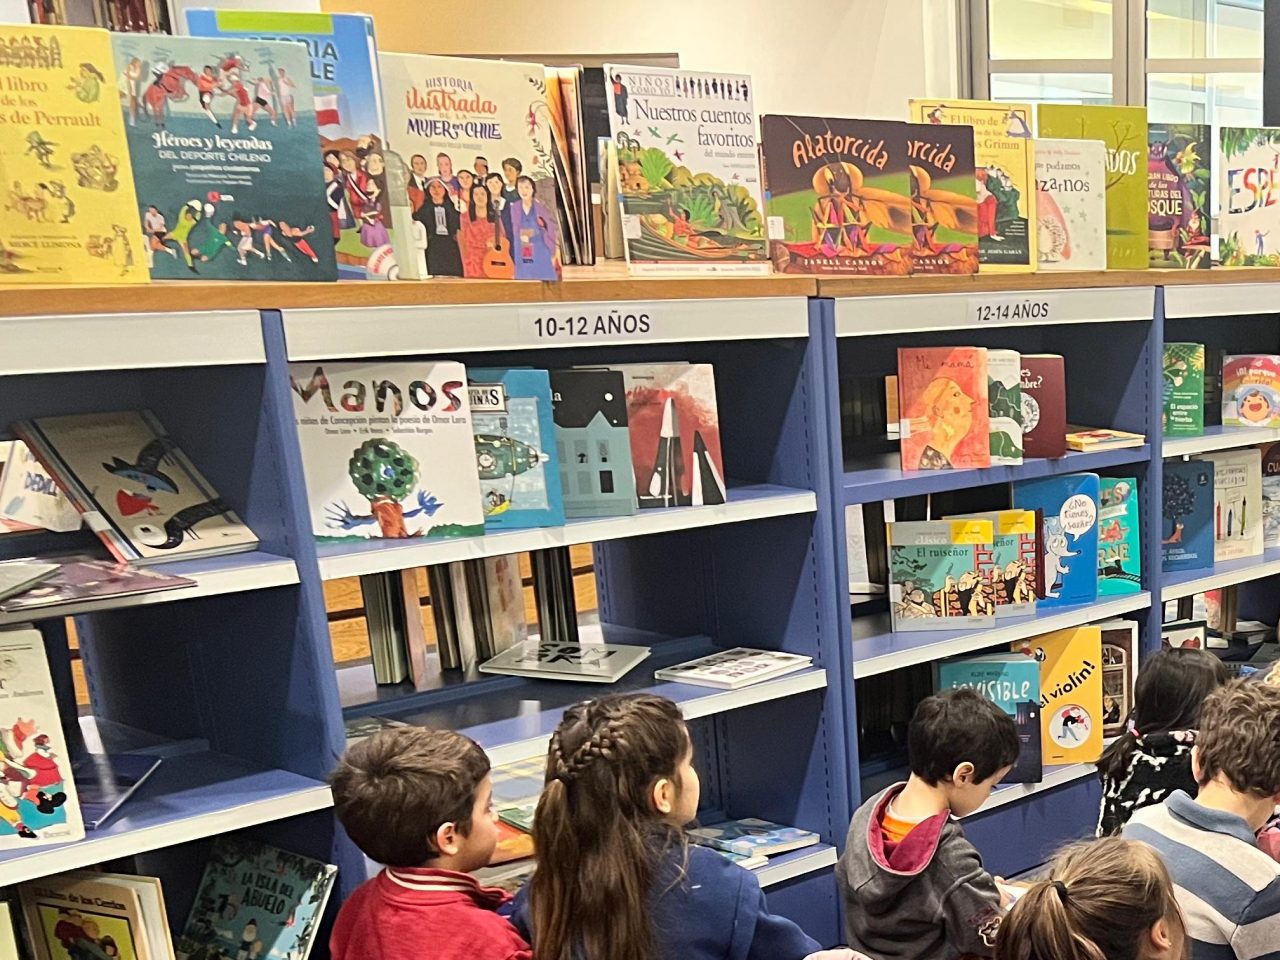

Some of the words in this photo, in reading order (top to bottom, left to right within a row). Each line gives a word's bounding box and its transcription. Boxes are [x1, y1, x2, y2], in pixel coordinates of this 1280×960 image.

[426, 77, 473, 91] HISTORIA
[628, 75, 670, 87] NIÑOS
[406, 86, 497, 114] ilustrada
[34, 111, 101, 127] Perrault
[634, 98, 697, 122] Nuestros
[701, 109, 752, 125] cuentos
[951, 115, 960, 124] El
[963, 115, 985, 125] libro
[987, 116, 999, 125] de
[407, 118, 458, 139] MUJER
[465, 121, 502, 139] CHILE
[698, 124, 754, 147] favoritos
[152, 130, 203, 149] Héroes
[215, 135, 273, 151] leyendas
[985, 141, 1020, 150] Grimm
[158, 150, 179, 160] DEL
[180, 151, 227, 161] DEPORTE
[228, 153, 272, 162] CHILENO
[792, 131, 889, 170] Alatorcida
[1046, 162, 1081, 172] podamos
[1162, 173, 1179, 182] LIBRO
[1170, 190, 1182, 198] DEL
[804, 259, 841, 267] JANELL
[977, 304, 1009, 320] 12-14
[1012, 299, 1049, 319] AÑOS
[534, 316, 588, 337] 10-12
[593, 310, 650, 335] AÑOS
[941, 354, 974, 368] mamá
[289, 366, 463, 416] Manos
[330, 416, 367, 426] Concepción
[917, 548, 926, 556] El
[930, 546, 968, 558] ruiseñor
[1049, 660, 1095, 698] violín!
[255, 873, 278, 894] ISLA
[240, 887, 286, 914] ABUELO
